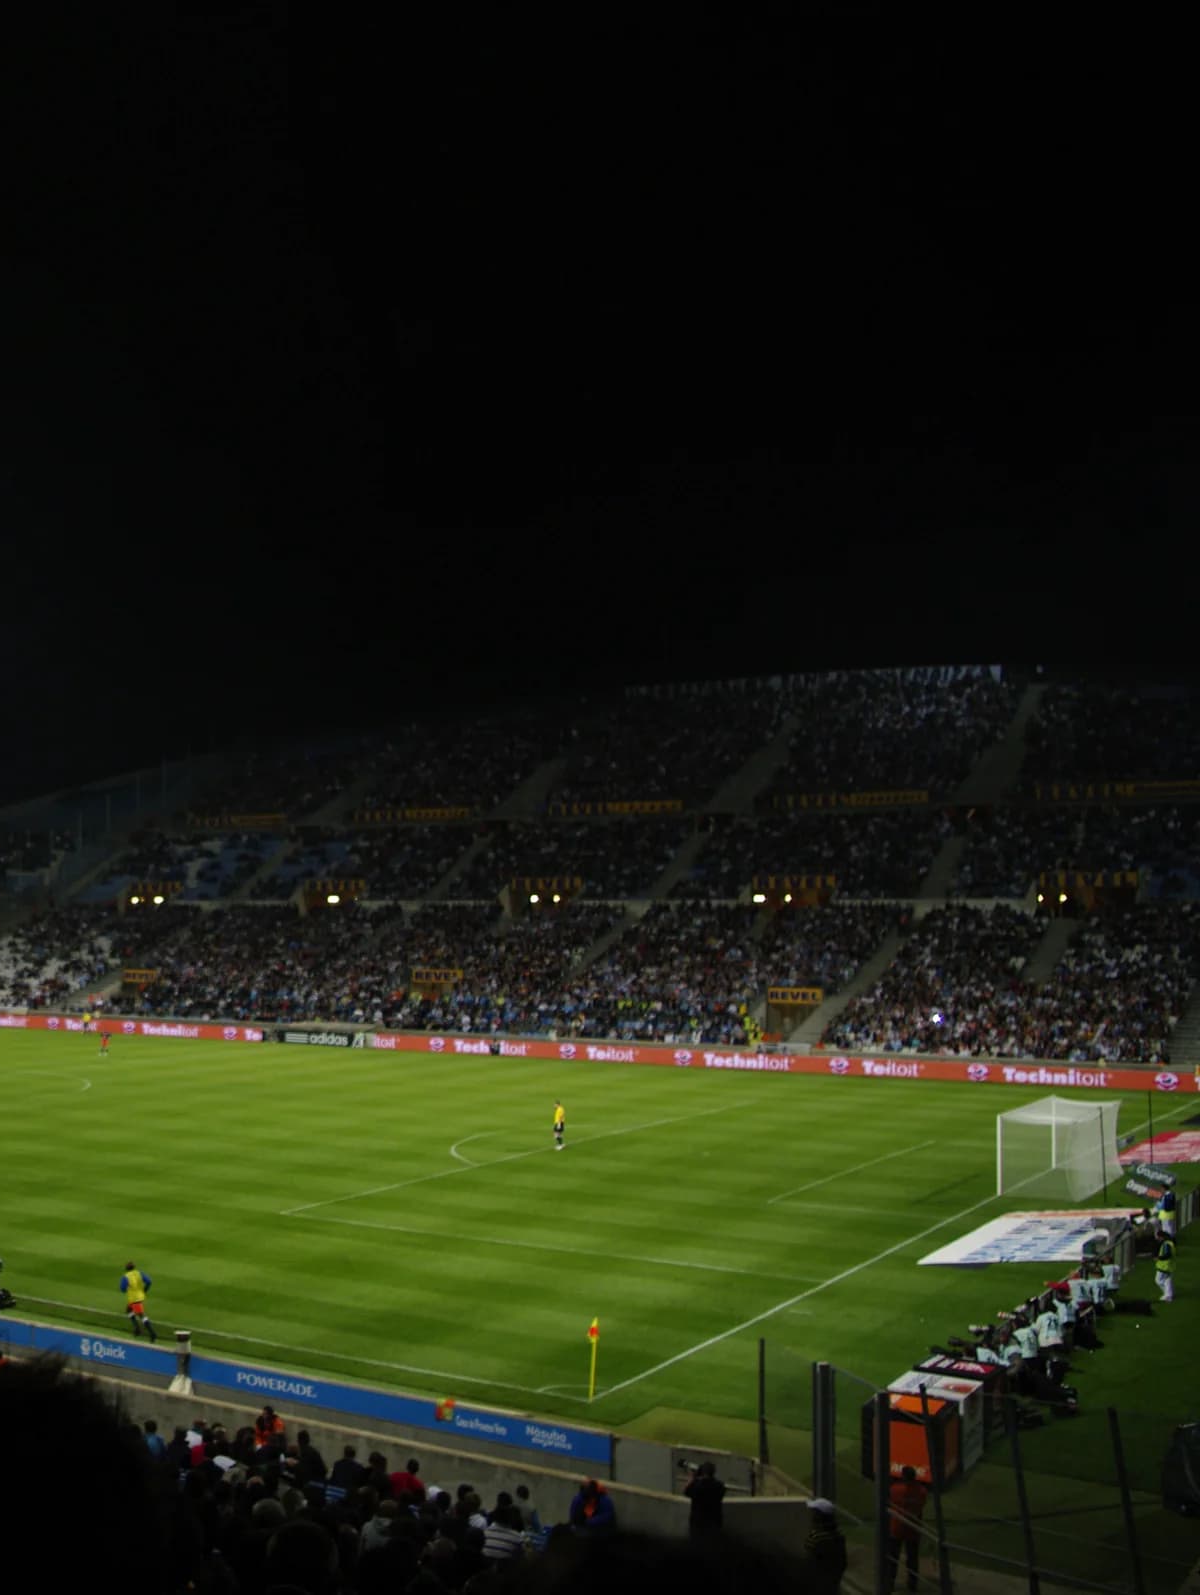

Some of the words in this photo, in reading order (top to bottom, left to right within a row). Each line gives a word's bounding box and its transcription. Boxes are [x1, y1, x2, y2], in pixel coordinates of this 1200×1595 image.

[309, 1031, 349, 1048] adidas
[703, 1052, 790, 1072] Technitoit
[1002, 1065, 1108, 1088] Technitoit
[92, 1341, 127, 1360] Quick
[236, 1371, 316, 1398] POWERADE
